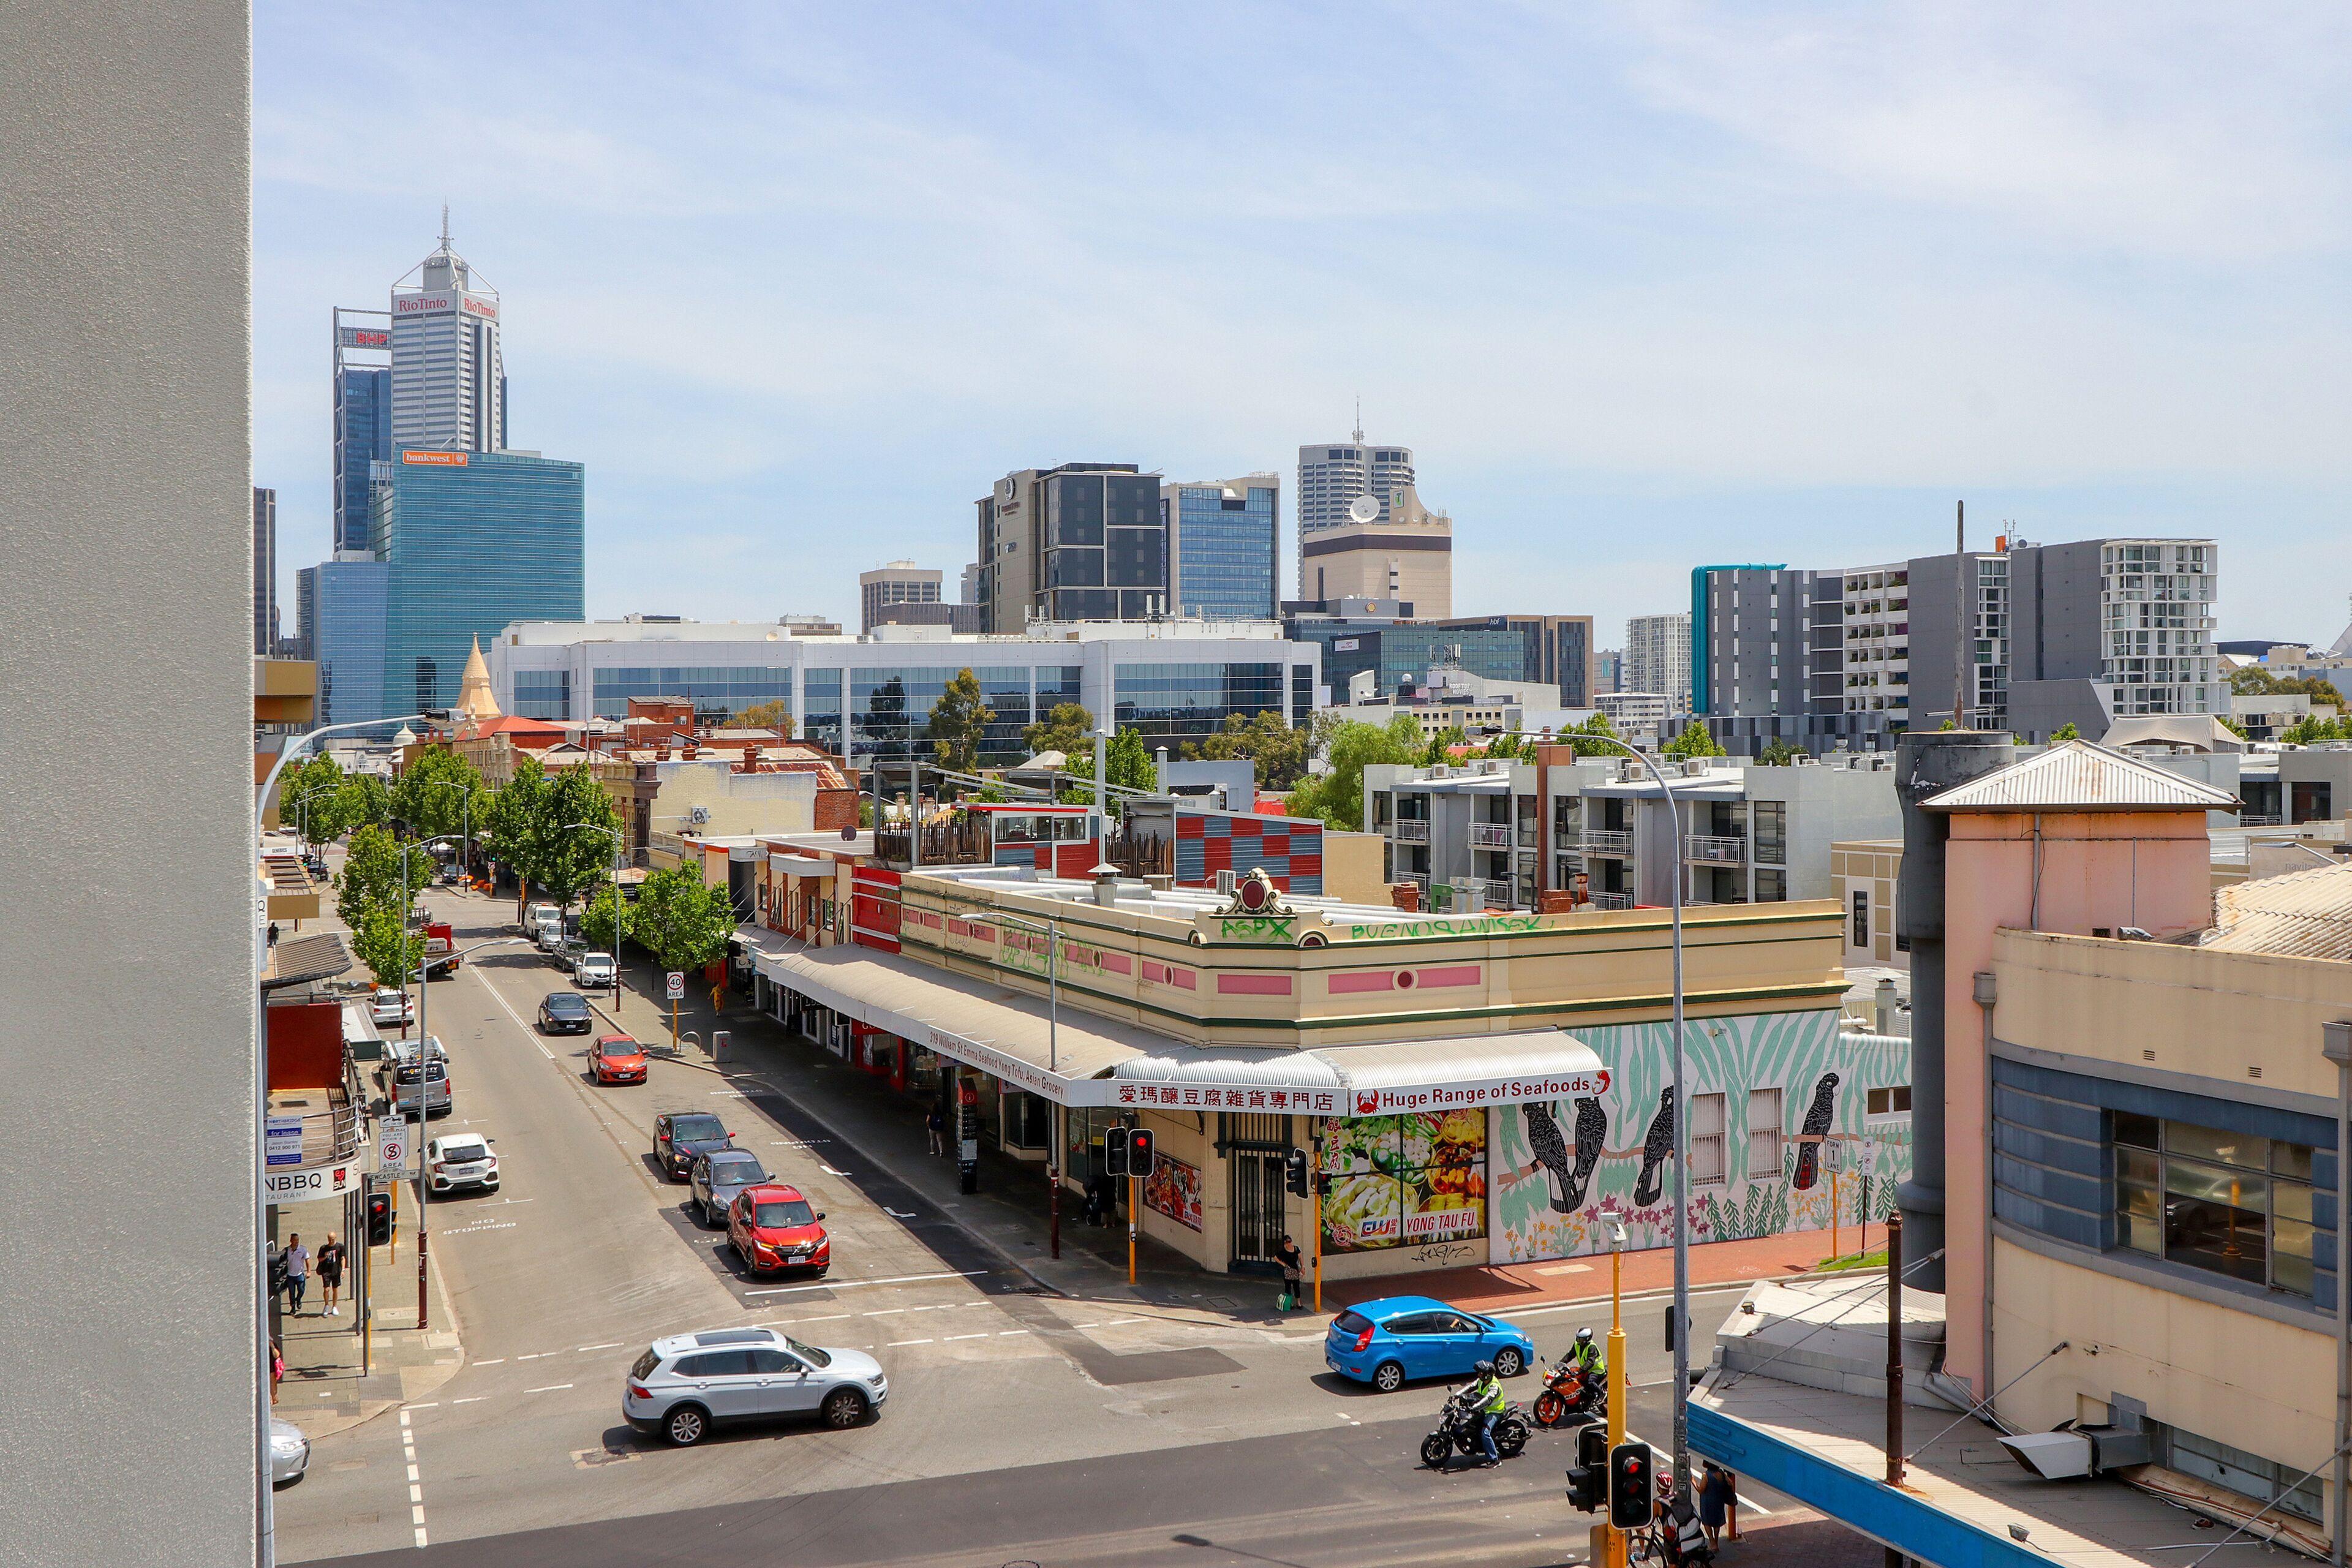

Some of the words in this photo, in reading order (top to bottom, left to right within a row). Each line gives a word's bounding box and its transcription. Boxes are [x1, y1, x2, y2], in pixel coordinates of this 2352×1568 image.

[356, 332, 387, 344] BHP
[406, 453, 450, 462] bankwest
[930, 1031, 938, 1044] 319
[939, 1034, 956, 1052] William
[957, 1042, 963, 1055] St
[964, 1045, 978, 1061] Emma
[978, 1050, 998, 1069] Seafood
[998, 1057, 1011, 1077] Yong
[1012, 1064, 1025, 1082] Tofu,
[1025, 1069, 1041, 1087] Asian
[1041, 1076, 1065, 1099] Grocery
[1118, 1084, 1333, 1111] 愛瑪釀豆腐雜貨專門店
[1383, 1092, 1428, 1109] Huge
[1433, 1087, 1486, 1105] Range
[1491, 1083, 1507, 1098] of
[1511, 1077, 1590, 1097] Seafoods
[1832, 1150, 1835, 1161] 1
[1827, 1162, 1840, 1170] LANE
[334, 1180, 346, 1189] SUN
[1407, 1216, 1434, 1232] YONG
[1439, 1213, 1459, 1229] TAU
[1462, 1212, 1476, 1227] FU
[443, 1223, 516, 1235] STOPPING
